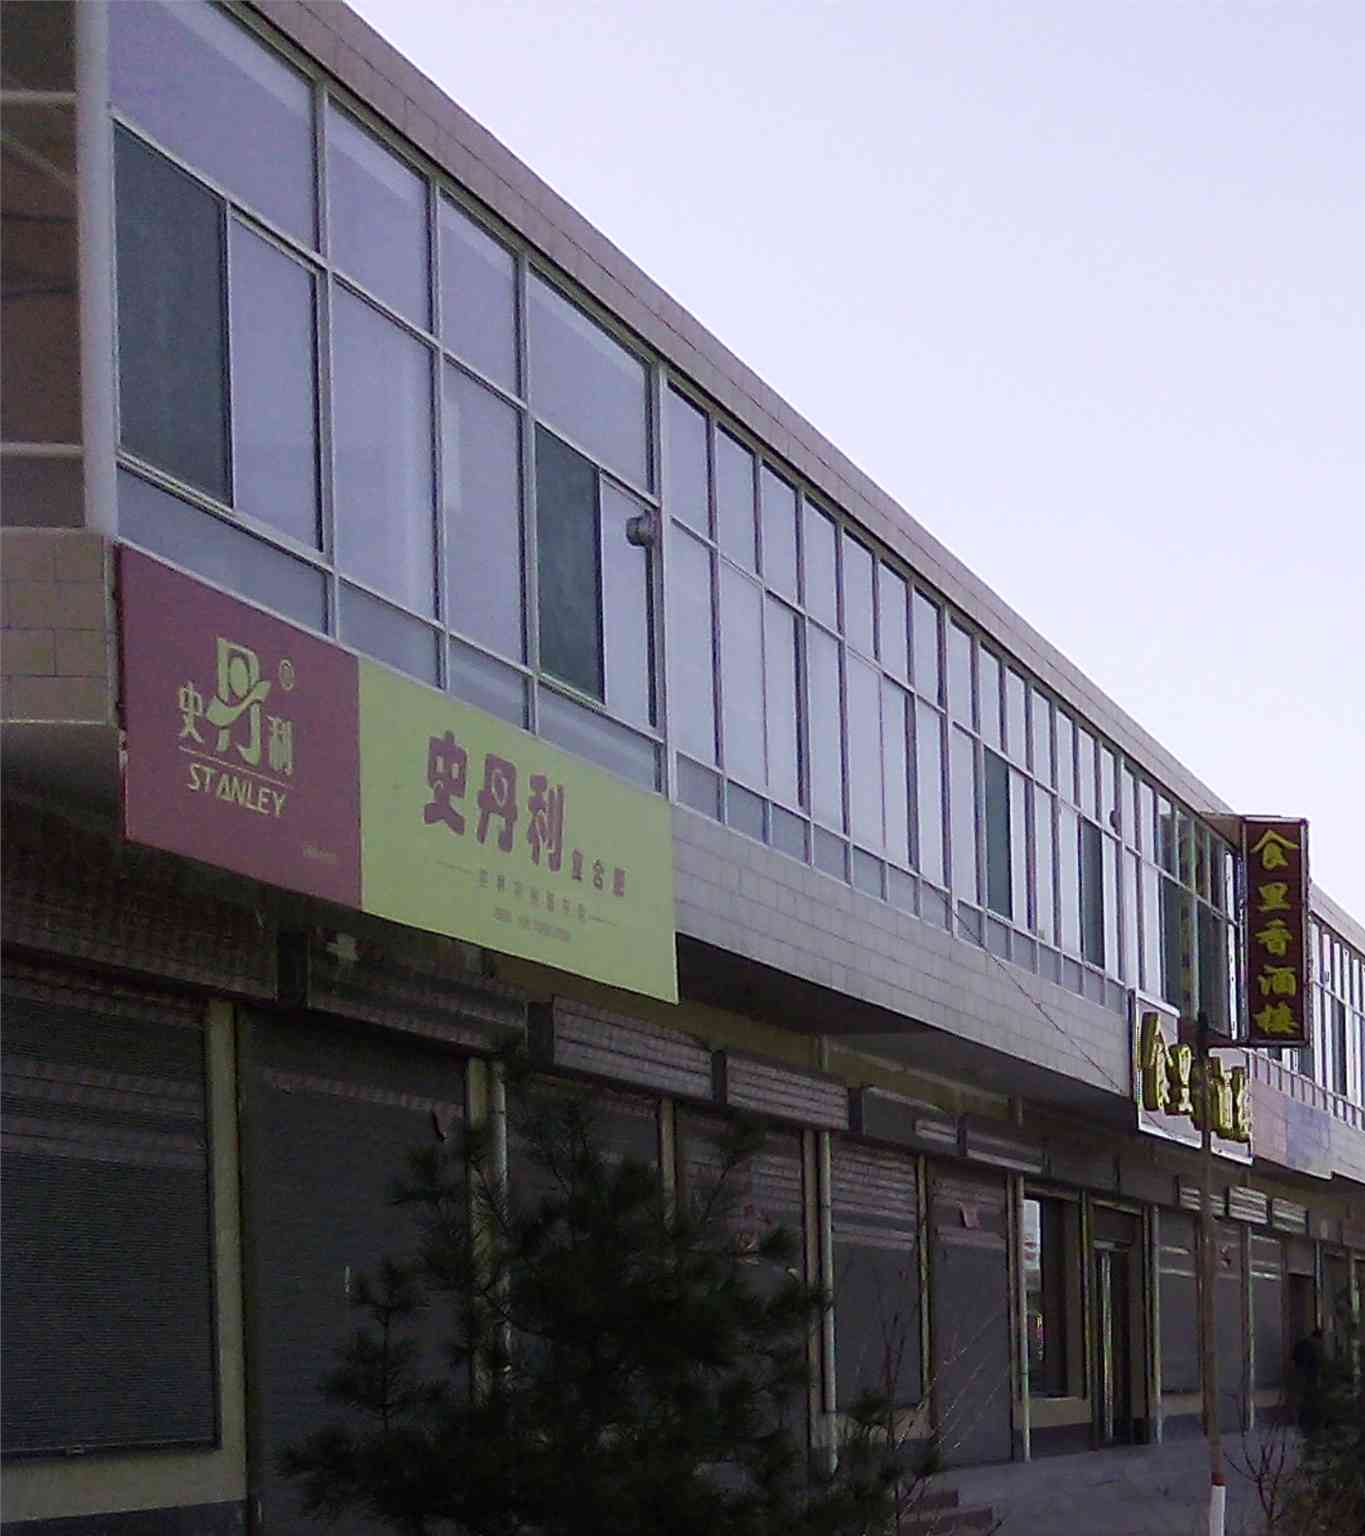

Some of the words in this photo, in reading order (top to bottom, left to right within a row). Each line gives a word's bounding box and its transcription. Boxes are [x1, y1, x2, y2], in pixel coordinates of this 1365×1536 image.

[188, 762, 286, 817] STANLEY
[424, 730, 564, 872] 史丹利
